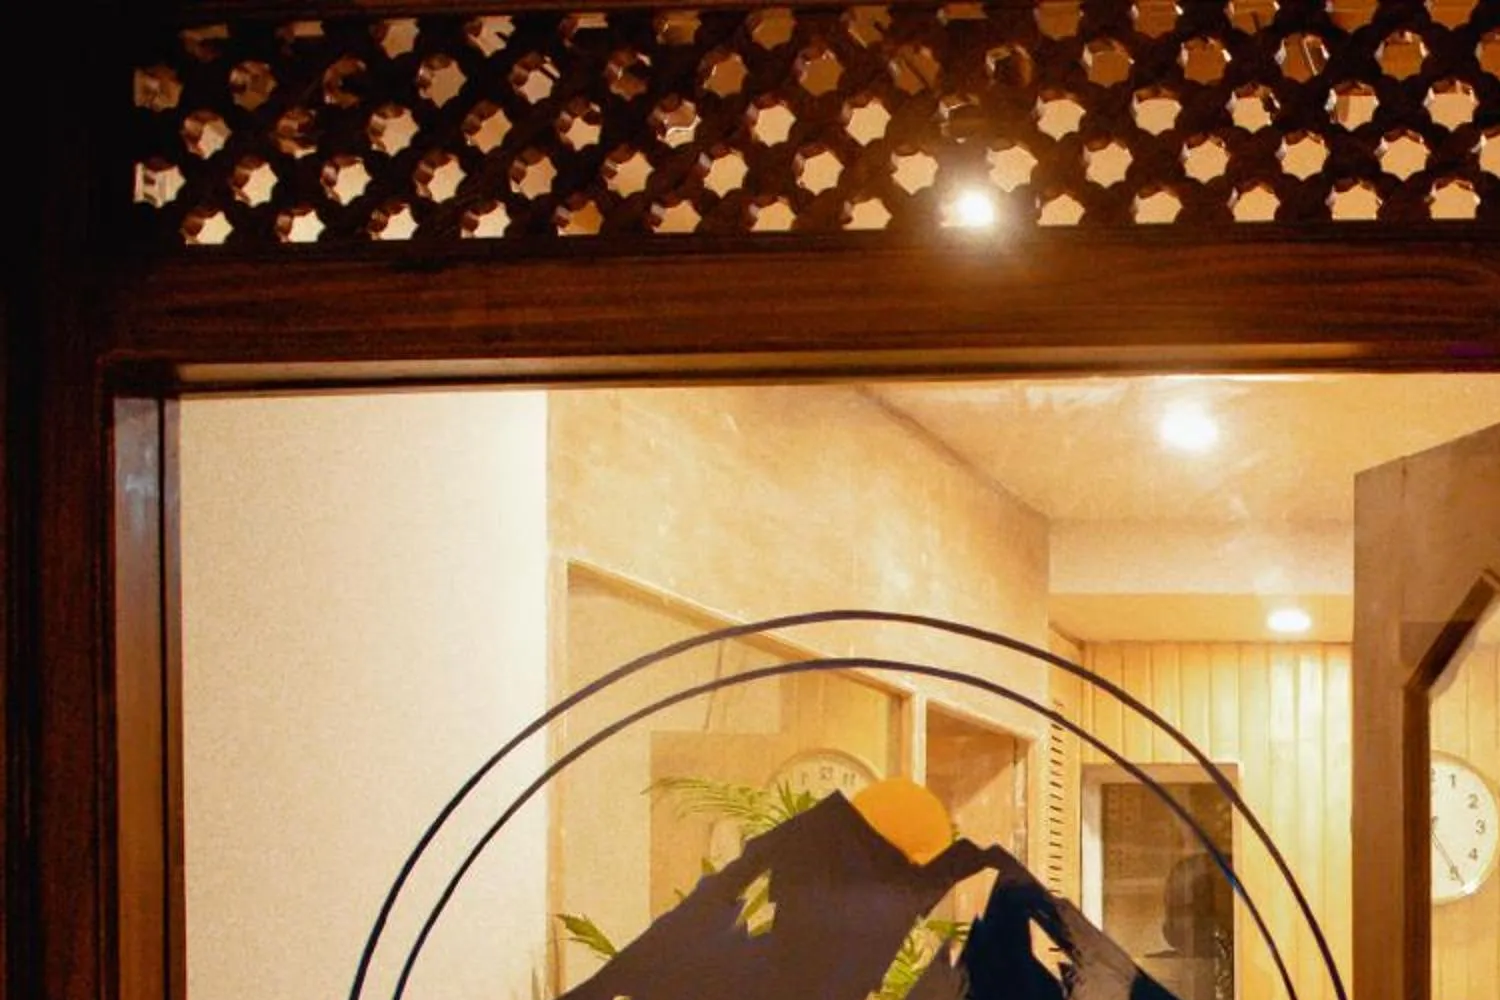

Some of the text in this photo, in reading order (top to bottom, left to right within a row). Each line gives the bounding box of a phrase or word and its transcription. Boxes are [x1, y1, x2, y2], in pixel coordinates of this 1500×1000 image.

[1449, 773, 1456, 788] 1
[1468, 794, 1479, 809] 2
[1475, 819, 1486, 835] 3
[1468, 847, 1478, 861] 4
